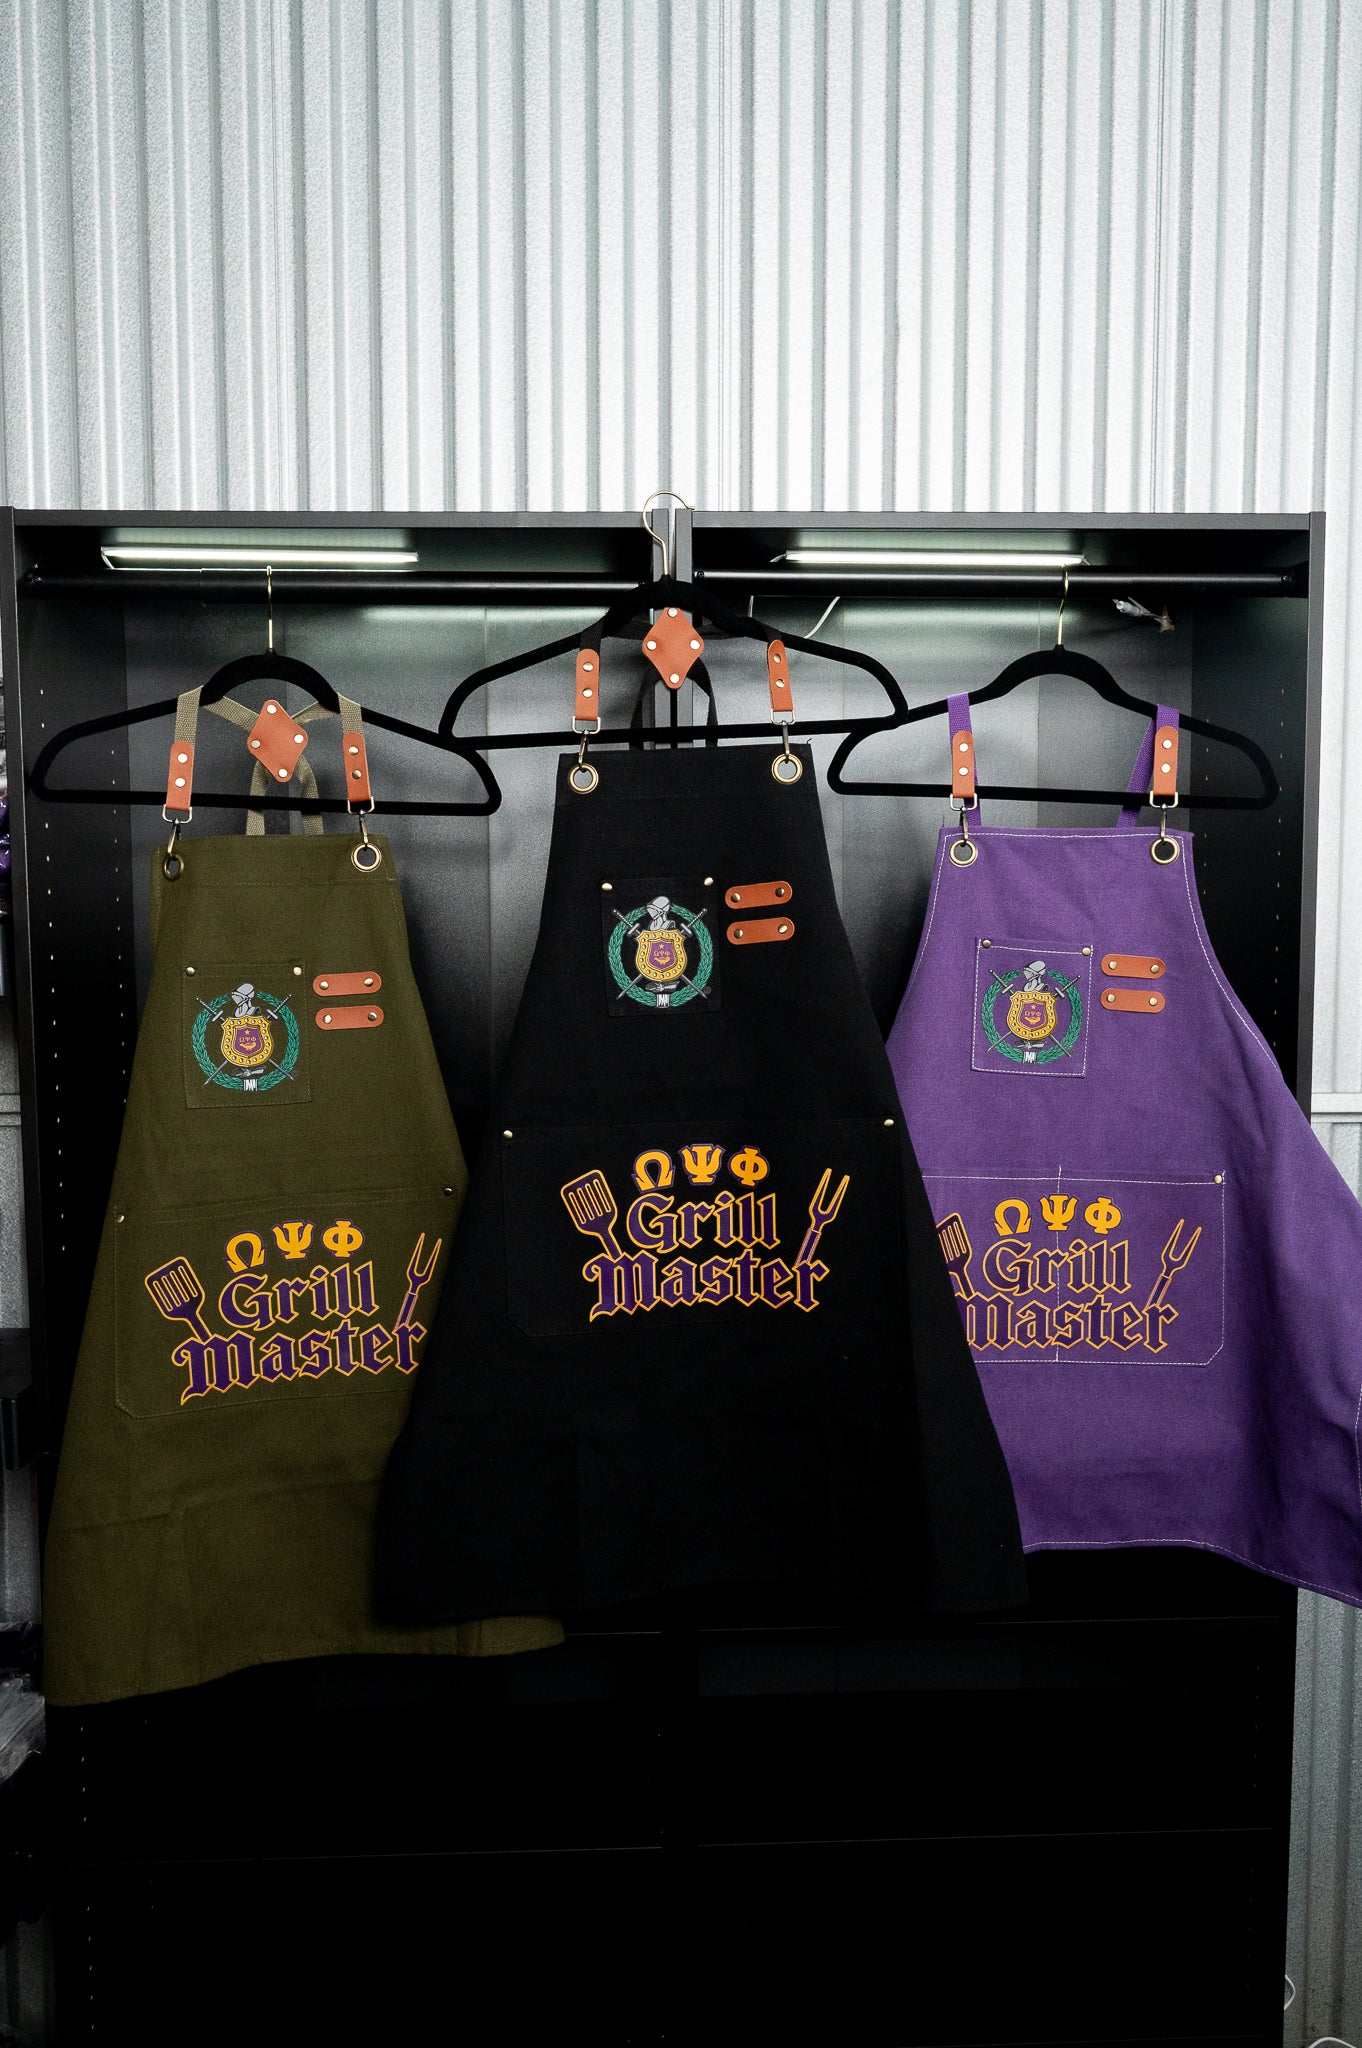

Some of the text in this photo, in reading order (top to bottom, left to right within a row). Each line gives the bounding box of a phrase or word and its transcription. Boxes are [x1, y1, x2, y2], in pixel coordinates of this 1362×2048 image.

[626, 1190, 781, 1253] Grill
[218, 1261, 379, 1331] Grill
[582, 1249, 830, 1322] Master
[983, 1238, 1132, 1296] Grill
[171, 1318, 427, 1406] Master
